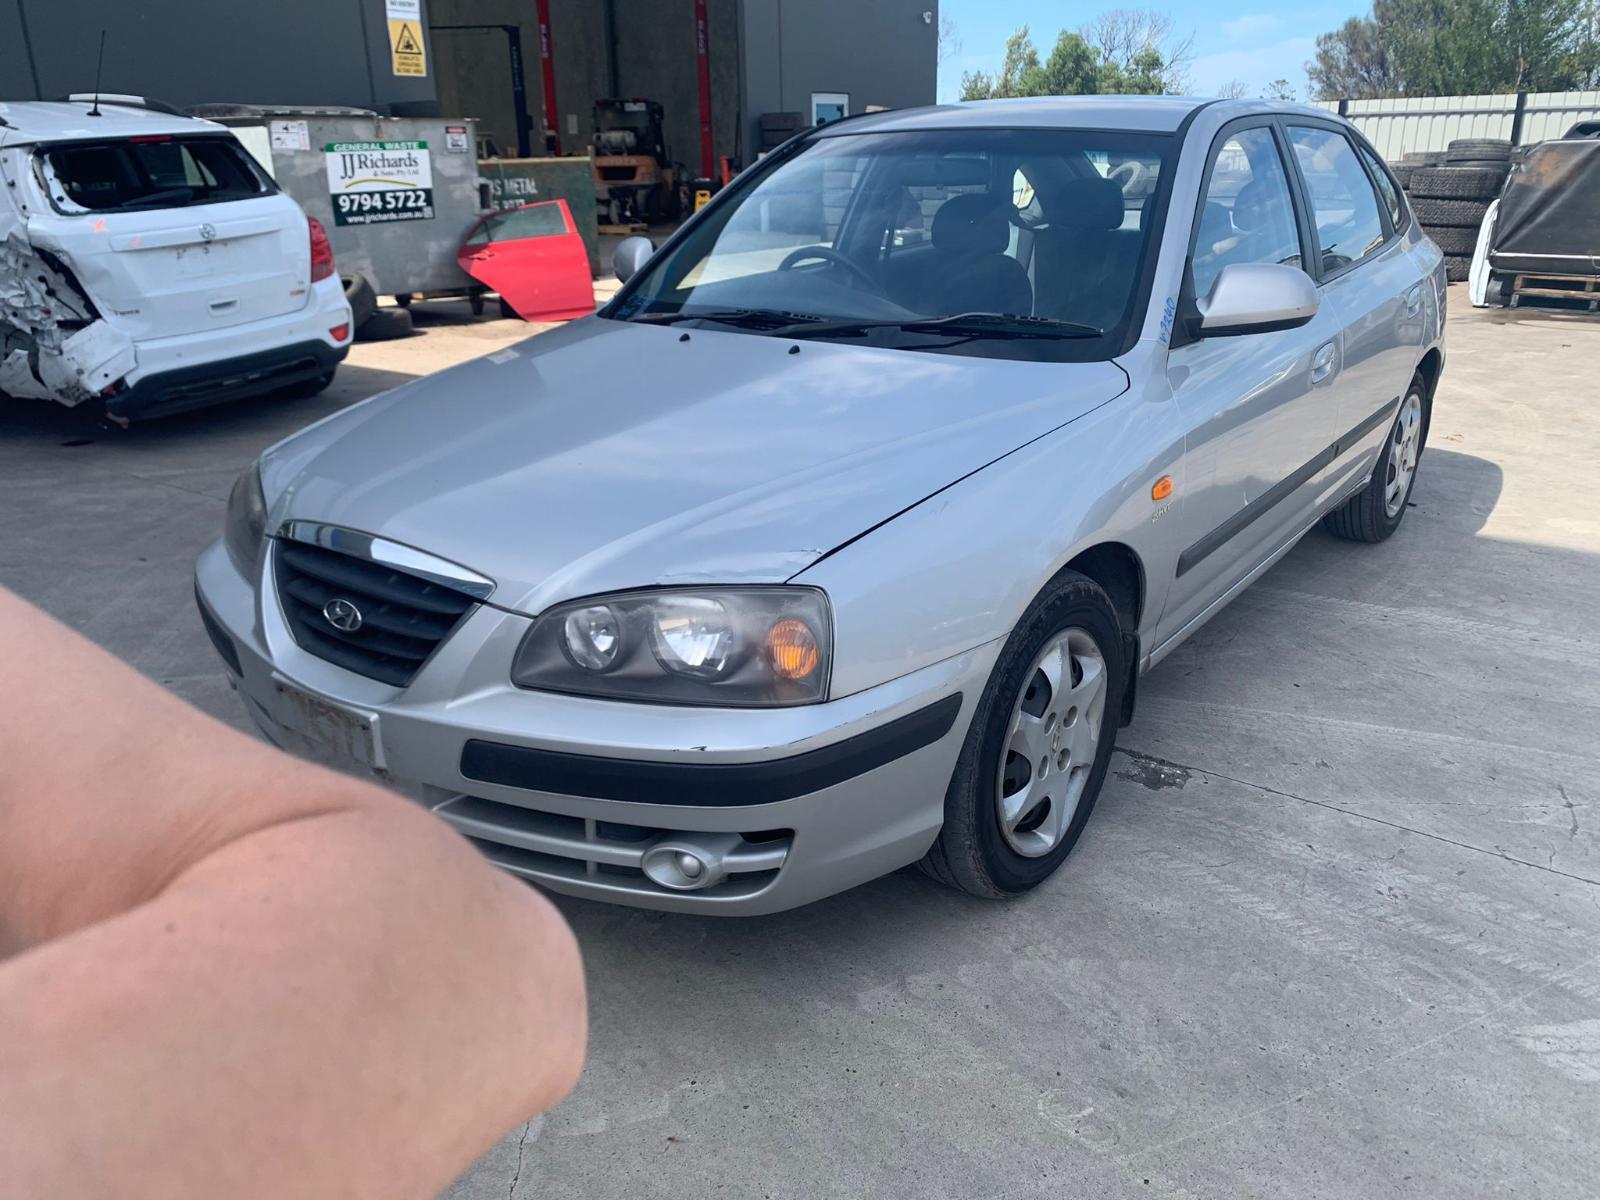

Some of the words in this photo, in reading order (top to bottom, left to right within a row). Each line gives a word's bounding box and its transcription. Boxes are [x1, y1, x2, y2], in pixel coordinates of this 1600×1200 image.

[334, 143, 382, 151] GENERAL
[384, 141, 418, 150] WASTE
[358, 152, 419, 169] Richards
[338, 193, 383, 213] 9794
[385, 190, 427, 210] 5722
